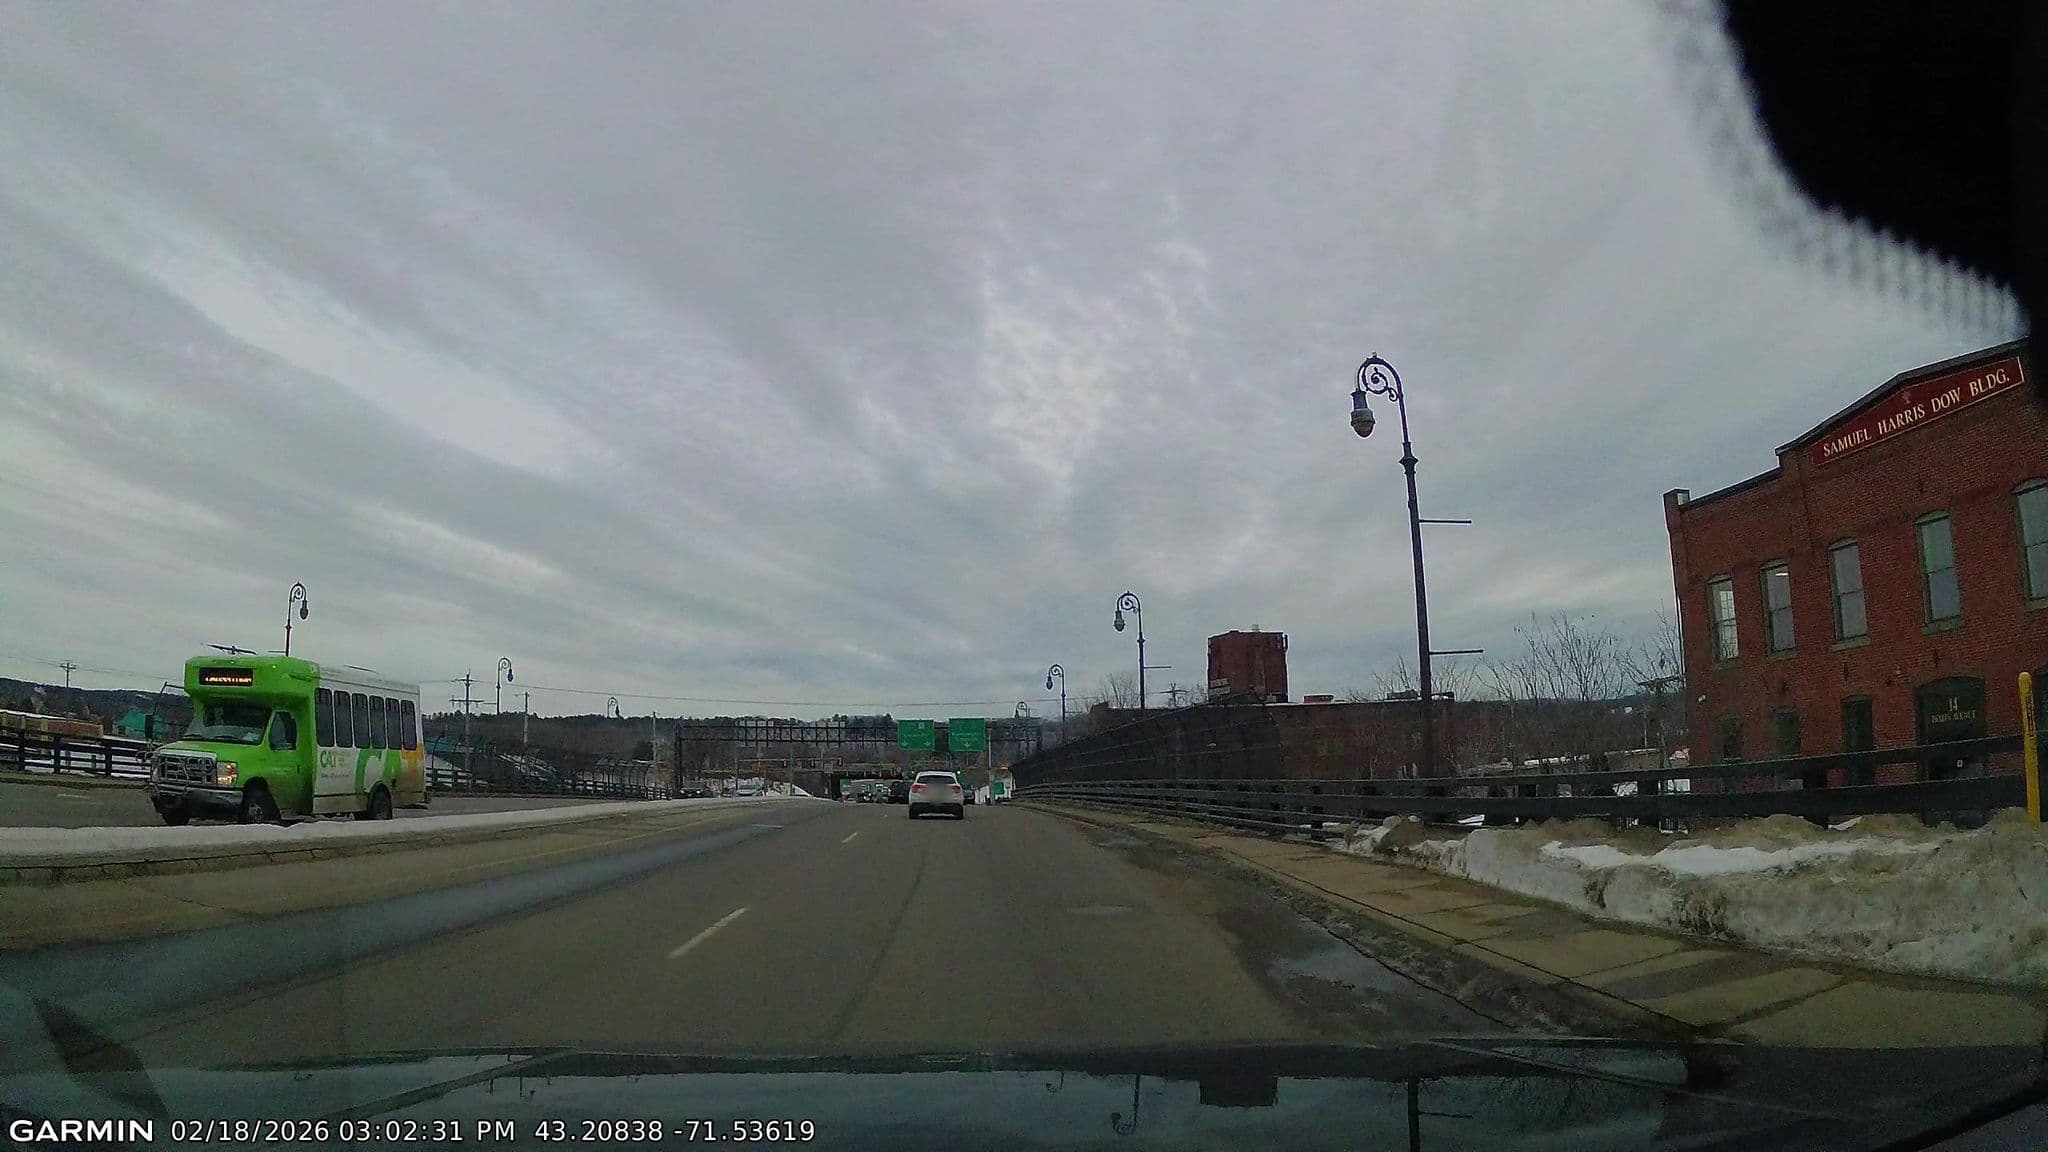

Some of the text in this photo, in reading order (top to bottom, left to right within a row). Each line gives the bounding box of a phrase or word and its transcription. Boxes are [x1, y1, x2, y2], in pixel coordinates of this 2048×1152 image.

[1823, 368, 2010, 457] SAMUEL HARRIS DOW BLDG.
